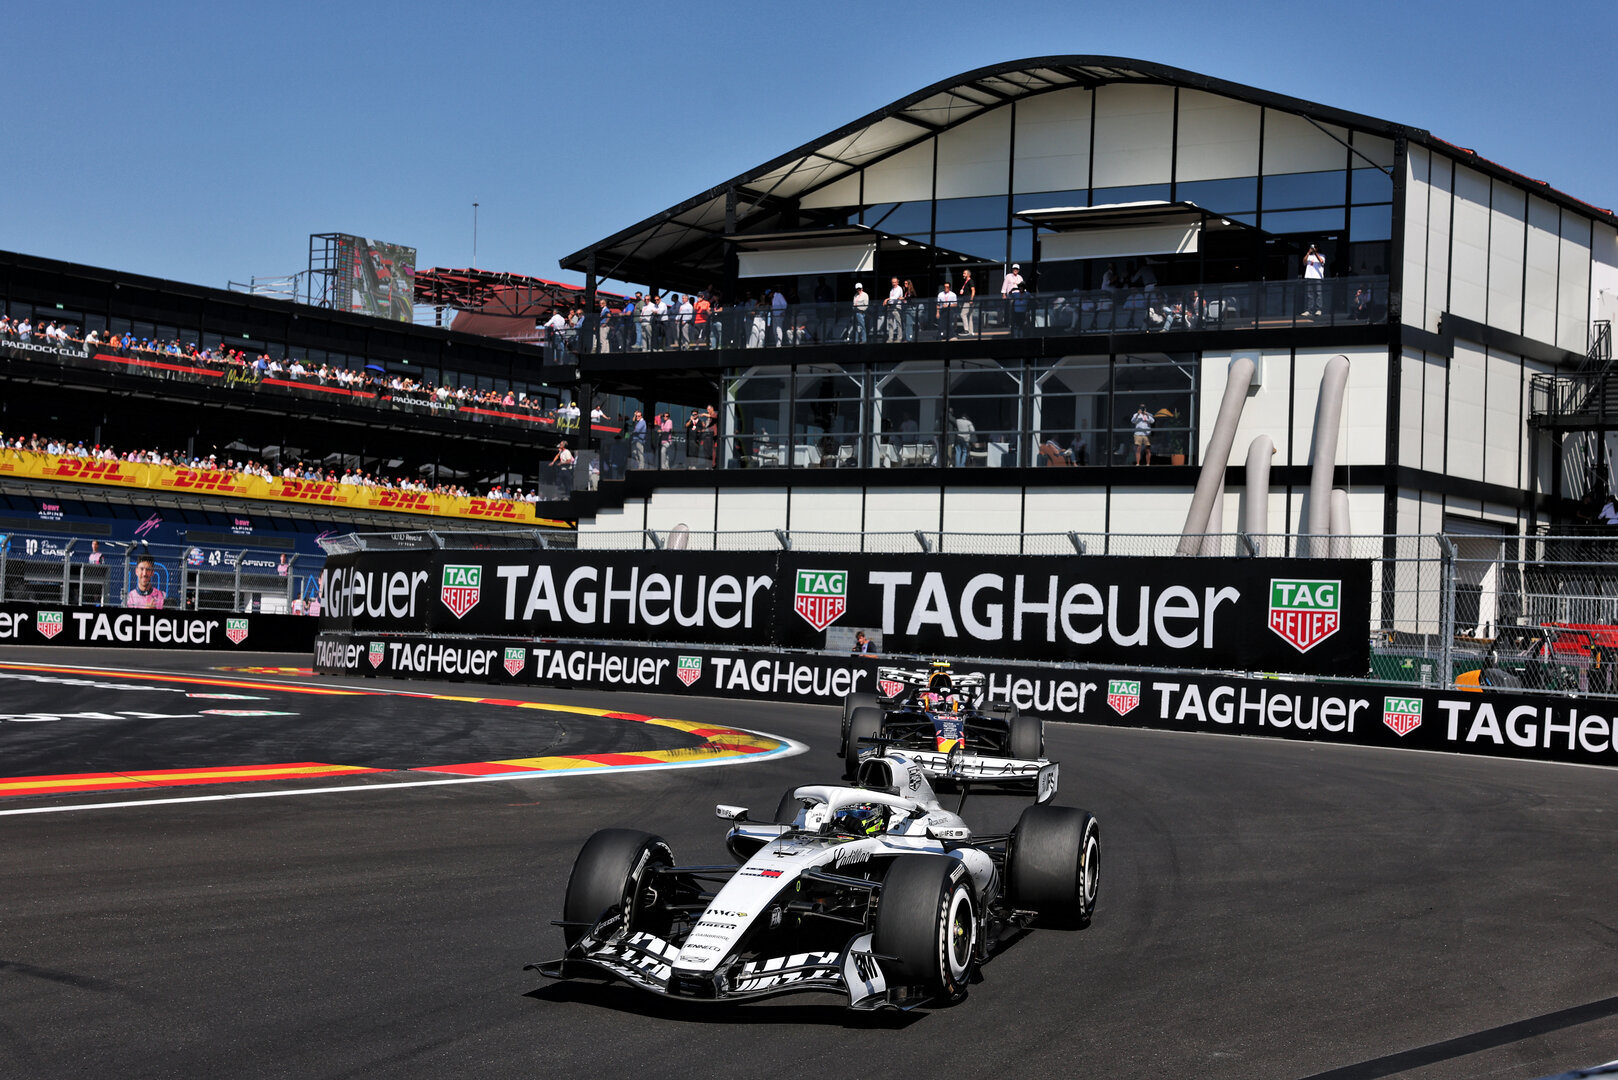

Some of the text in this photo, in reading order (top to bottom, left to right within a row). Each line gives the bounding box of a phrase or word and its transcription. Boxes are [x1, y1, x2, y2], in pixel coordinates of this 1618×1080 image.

[1, 340, 89, 359] PADDOCK CLUB
[392, 396, 455, 410] PADDOCK CLUB
[56, 459, 124, 481] DHL
[174, 470, 236, 492] DHL
[280, 481, 337, 501] DHL
[378, 491, 432, 510] DHL
[469, 500, 517, 518] DHL
[25, 538, 38, 556] 10
[208, 550, 221, 567] 43
[224, 559, 276, 568] COAPINTO
[446, 568, 479, 585] TAG
[800, 573, 844, 593] TAG
[442, 588, 479, 615] HEUER
[496, 565, 773, 629] TAGHeuer
[1276, 584, 1334, 607] TAG
[41, 612, 61, 622] TAG
[797, 596, 844, 627] HEUER
[868, 571, 1241, 649] TAGHeuer
[38, 622, 62, 638] HEUER
[72, 612, 219, 644] TAGHeuer
[228, 619, 247, 629] TAG
[1272, 611, 1336, 648] HEUER
[226, 629, 248, 643] HEUER
[316, 641, 365, 669] TAGHeuer
[370, 643, 384, 652] TAG
[506, 649, 524, 659] TAG
[389, 642, 498, 675] TAGHeuer
[504, 659, 525, 675] HEUER
[533, 649, 669, 685] TAGHeuer
[680, 657, 701, 668] TAG
[677, 668, 702, 686] HEUER
[711, 657, 867, 697] TAGHeuer
[1112, 682, 1138, 694] TAG
[1109, 695, 1139, 714] HEUER
[1153, 682, 1370, 732] TAGHeuer
[1387, 699, 1420, 713] TAG
[1385, 713, 1421, 735] HEUER
[834, 847, 871, 870] Cadillac
[697, 921, 737, 930] PIRELLI
[683, 944, 721, 952] TENNECO
